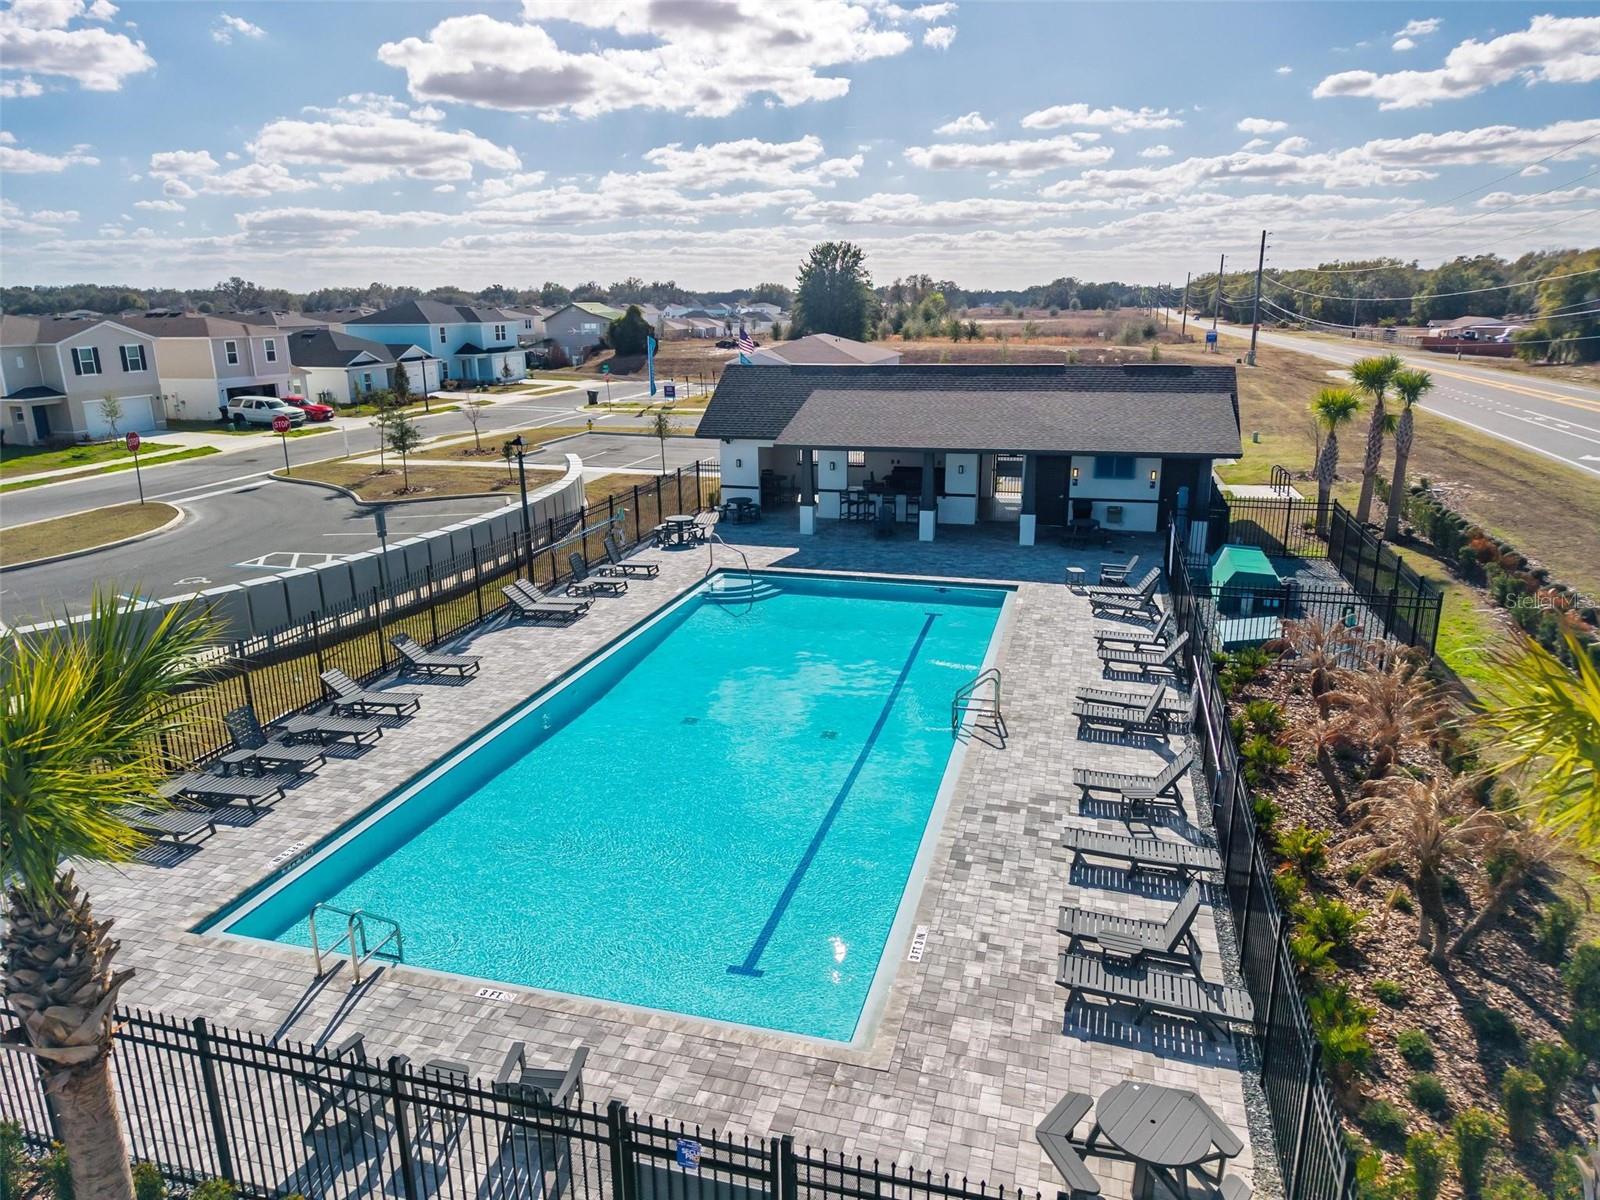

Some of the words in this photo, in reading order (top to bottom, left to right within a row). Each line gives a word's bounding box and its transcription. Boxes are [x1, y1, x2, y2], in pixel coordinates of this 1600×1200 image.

[273, 420, 289, 428] STOP
[128, 437, 139, 446] STOP
[489, 990, 503, 998] FT
